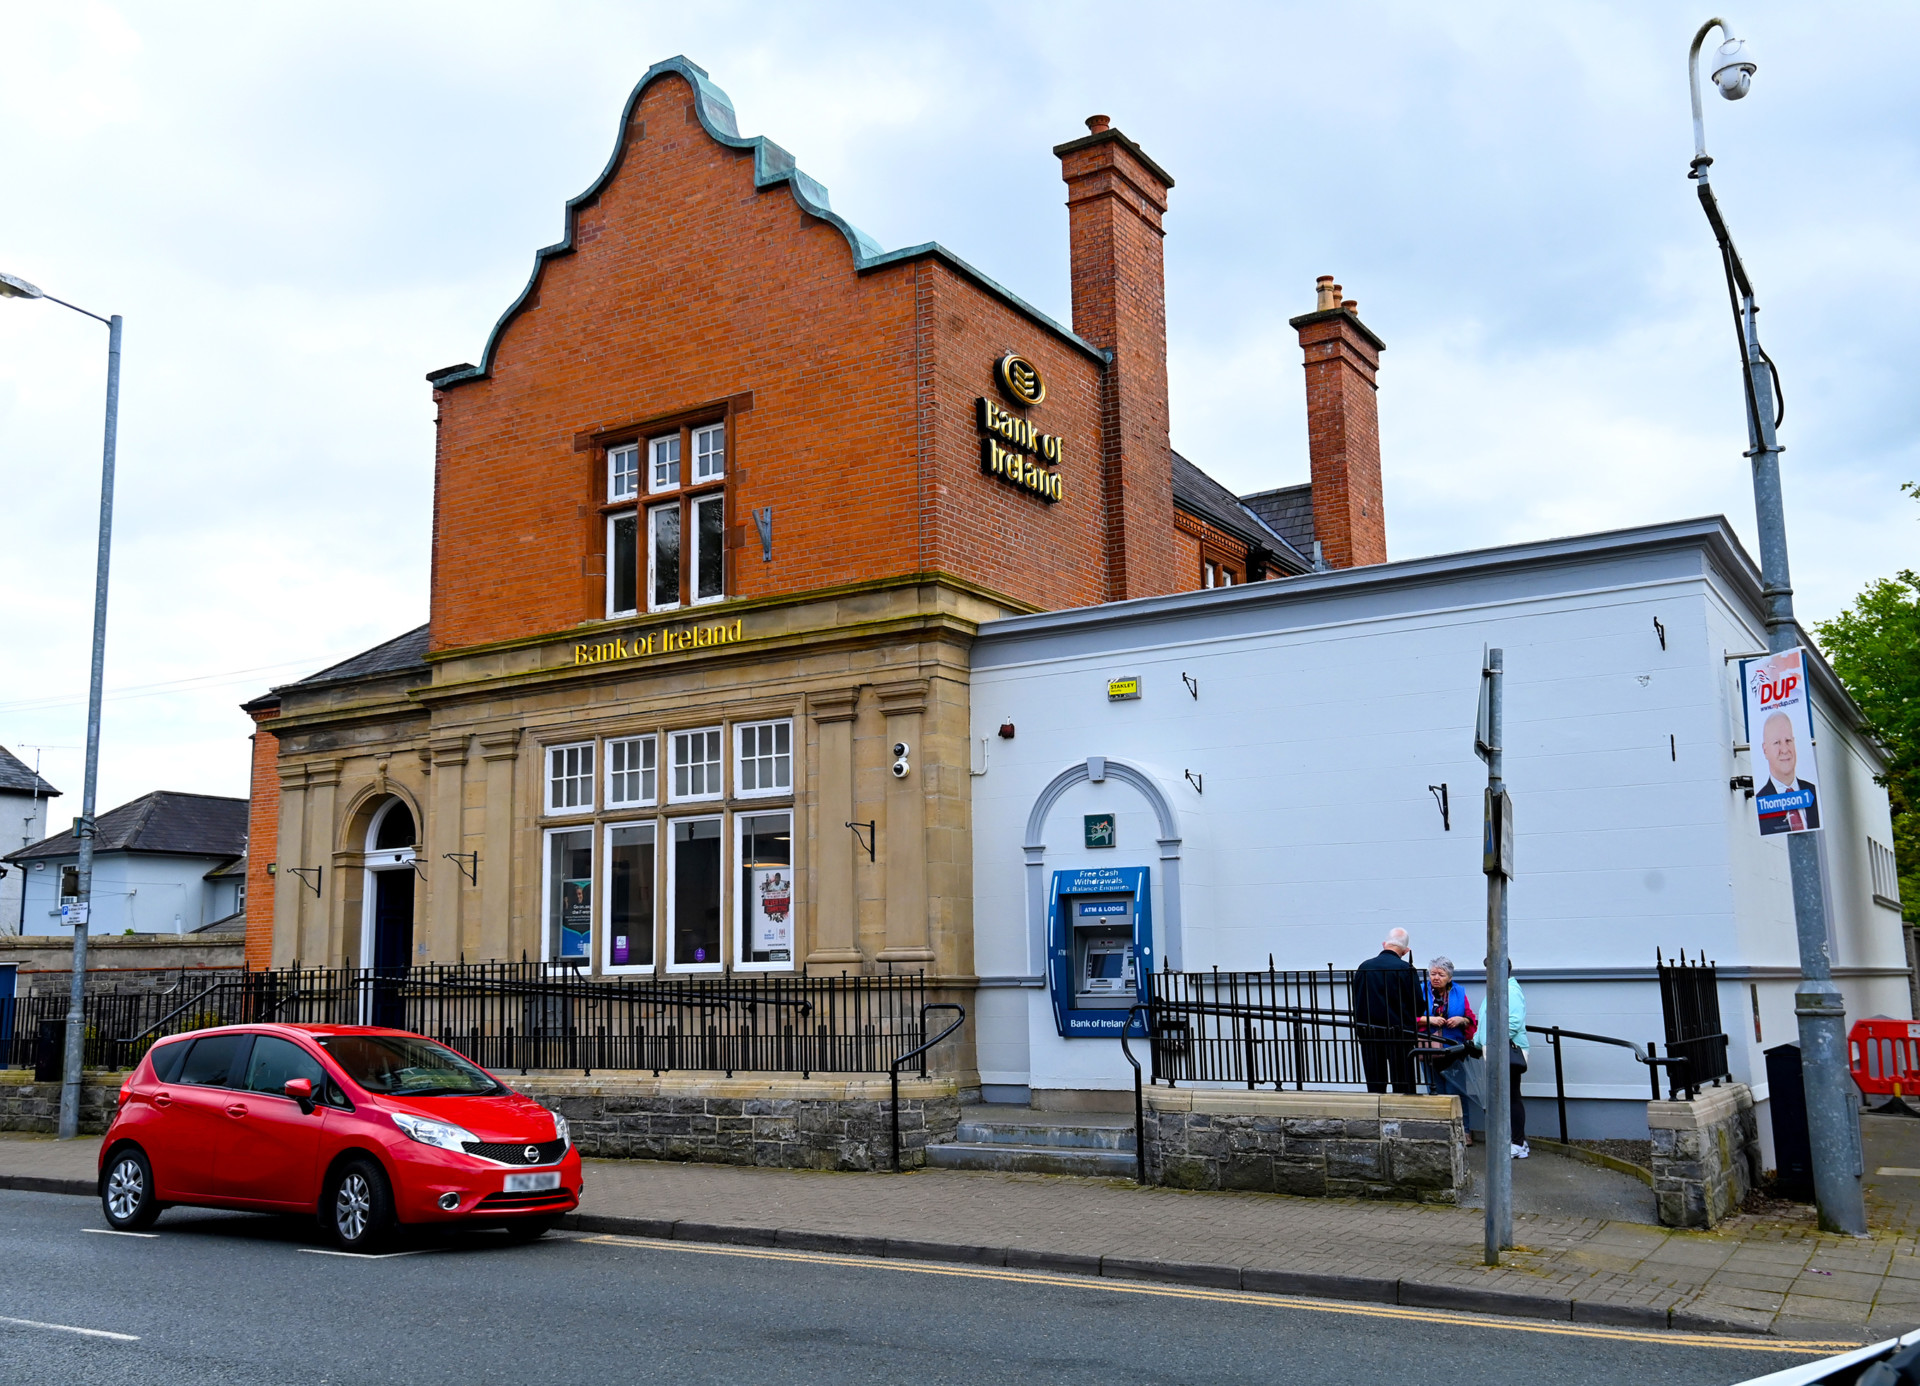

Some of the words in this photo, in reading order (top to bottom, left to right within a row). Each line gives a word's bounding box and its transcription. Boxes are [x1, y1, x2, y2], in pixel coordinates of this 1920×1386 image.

[984, 398, 1038, 453] Bank
[1042, 434, 1064, 465] of
[989, 438, 1063, 501] Ireland
[575, 638, 628, 665] Bank
[634, 632, 656, 656] of
[663, 619, 742, 651] Ireland
[1761, 676, 1797, 704] DUP
[1760, 698, 1799, 712] www.mydup.com
[1758, 795, 1803, 811] Thompson
[1803, 791, 1810, 804] 1
[1074, 877, 1123, 886] Withdrawals
[1079, 870, 1097, 878] Free
[1098, 869, 1119, 877] Cash
[1099, 884, 1130, 892] Enquiries
[1070, 1019, 1091, 1028] Bank
[1091, 1019, 1100, 1028] of
[1100, 1019, 1126, 1028] Irelan
